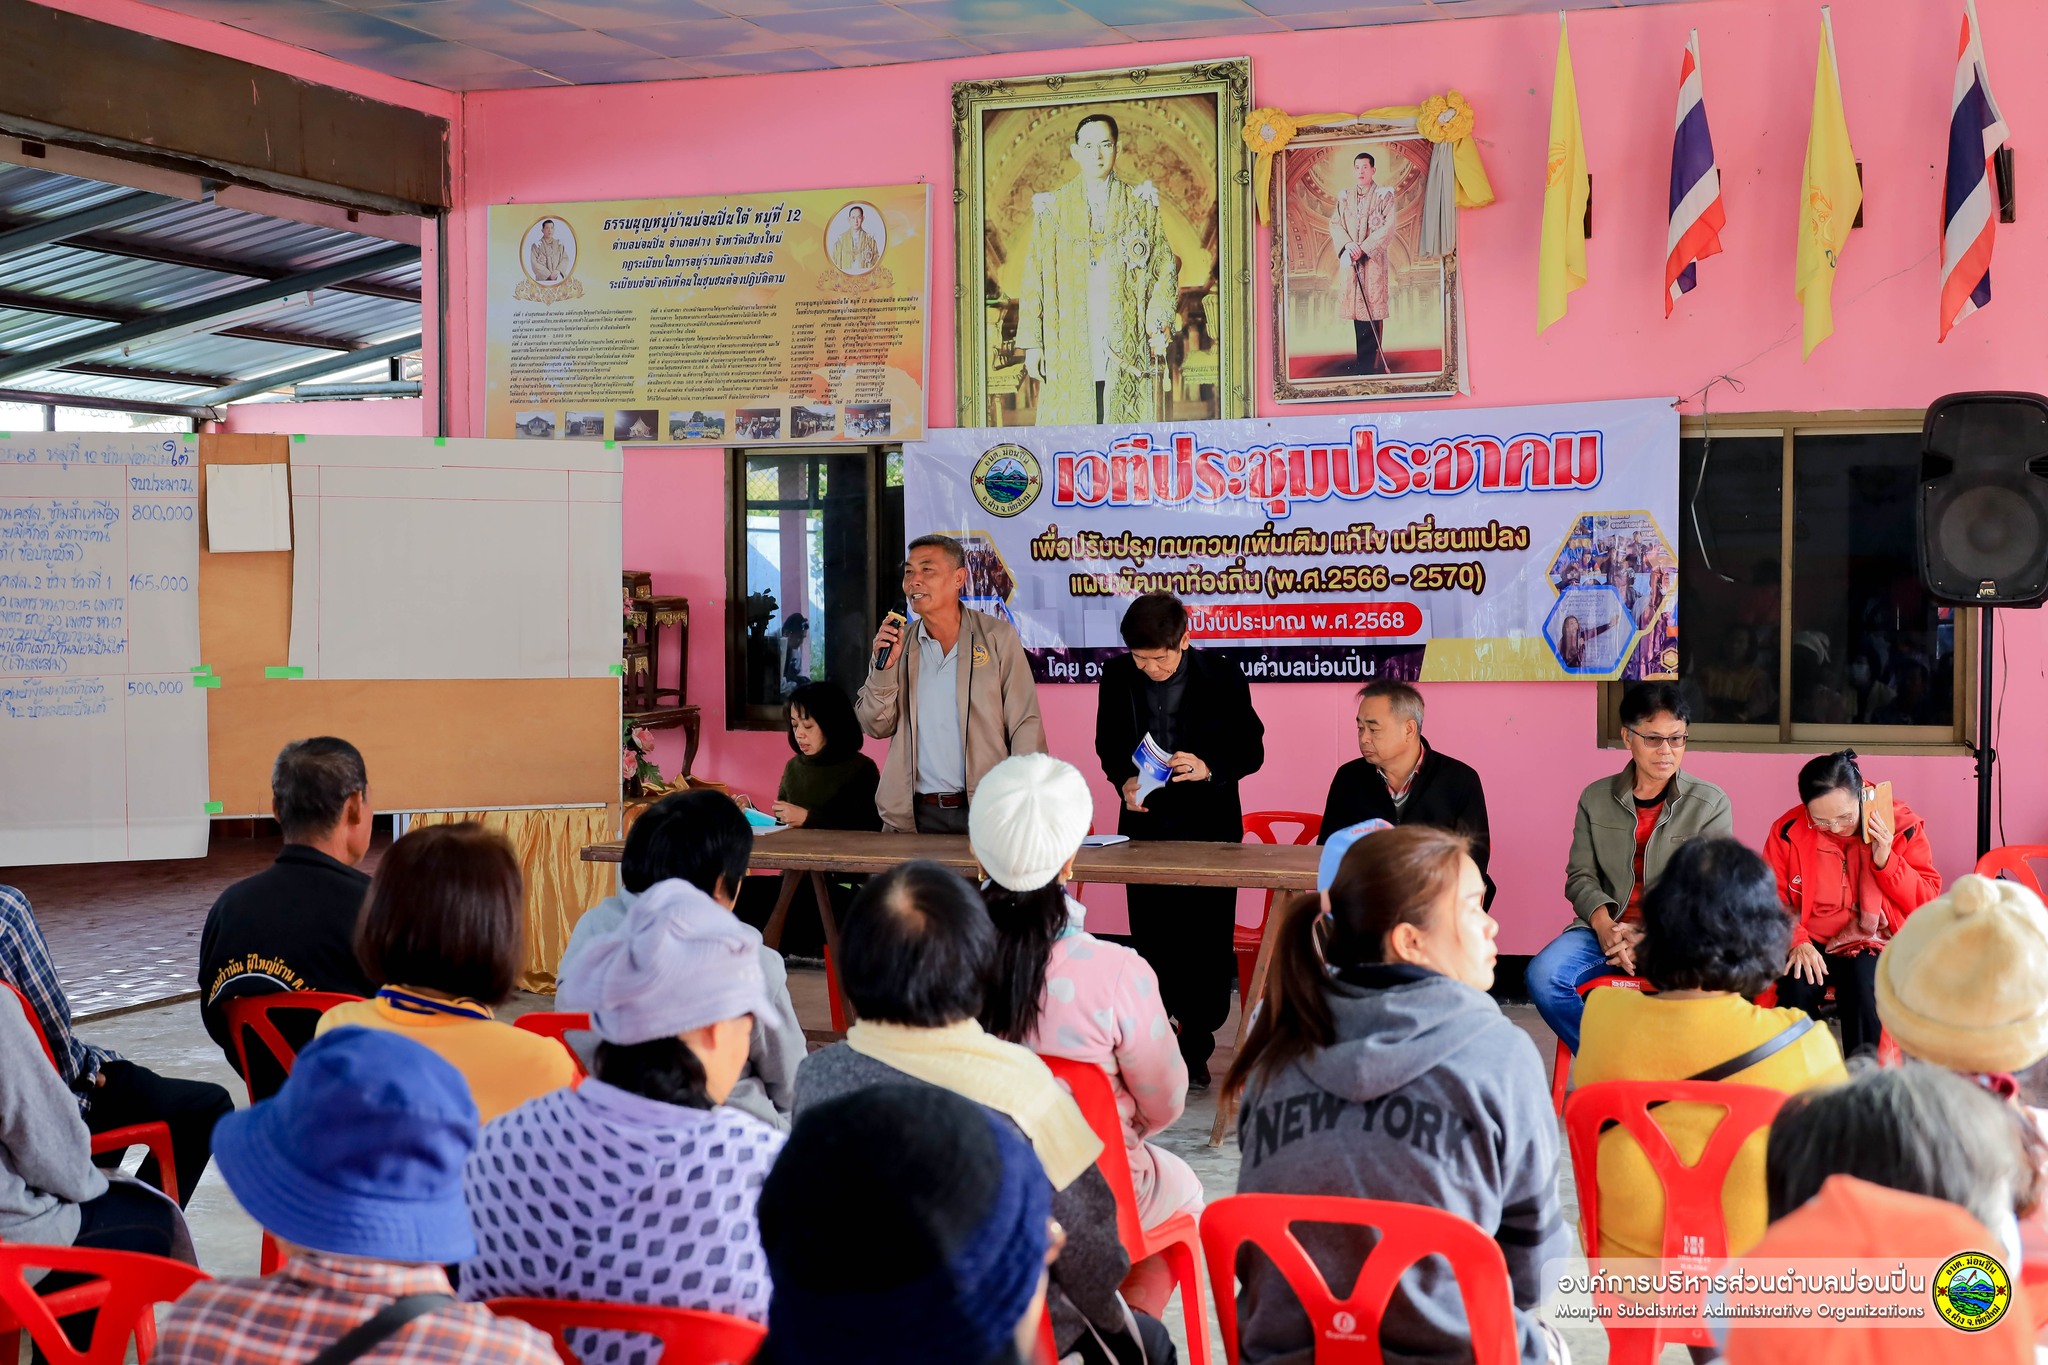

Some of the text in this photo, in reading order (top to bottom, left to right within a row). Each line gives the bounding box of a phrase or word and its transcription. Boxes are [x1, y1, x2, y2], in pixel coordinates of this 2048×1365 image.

[754, 202, 784, 229] หมู่ที่
[786, 209, 802, 223] 12
[129, 471, 193, 492] งบประมาณ
[1053, 425, 1603, 518] เวทีประชุมประชาคม
[132, 504, 193, 522] 800,000
[1030, 513, 1530, 567] เพื่อปรับปรุง ทบทวน เพิ่มเติม แก้ไข เปลี่ยนแปลง
[130, 574, 188, 592] 165,000
[1069, 556, 1262, 596] แผนพัฒนาท้องถิ่น
[1311, 611, 1405, 630] พ.ศ.2568
[1047, 656, 1080, 677] โดย
[127, 681, 183, 697] 500,000
[247, 953, 295, 982] ผู้ใหญ่บ้าน
[1253, 1092, 1474, 1168] NEW YORK
